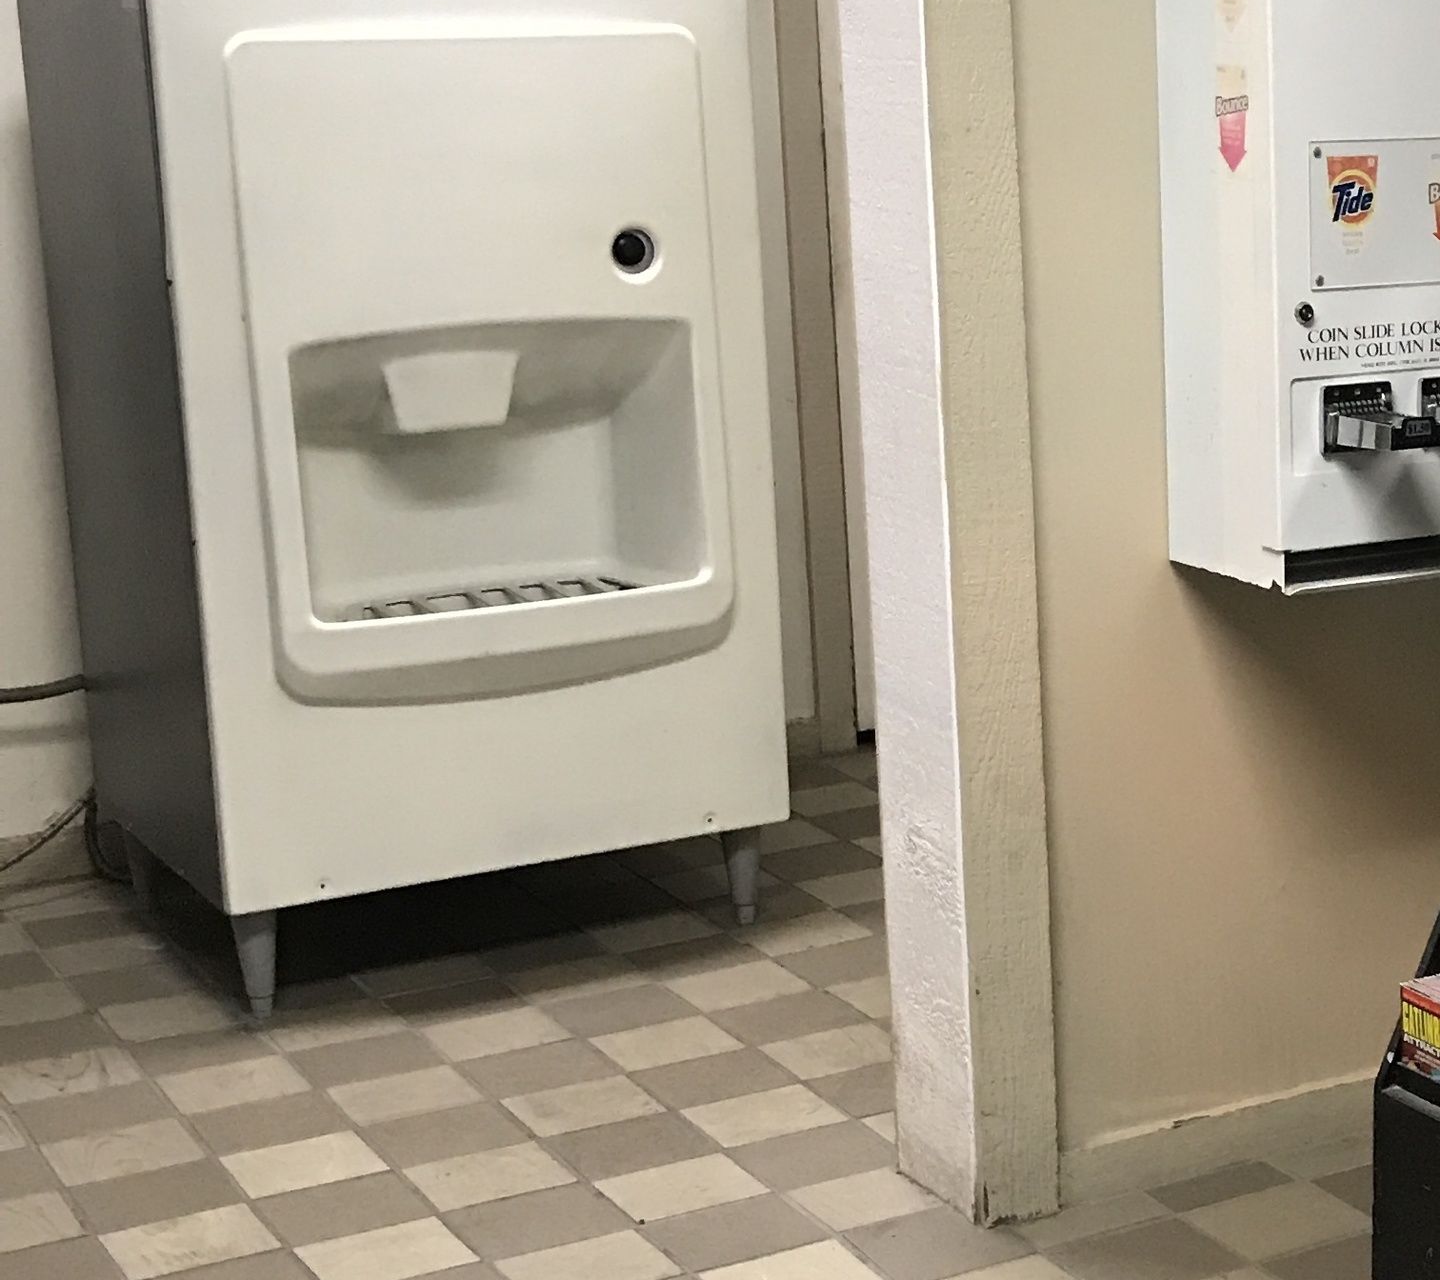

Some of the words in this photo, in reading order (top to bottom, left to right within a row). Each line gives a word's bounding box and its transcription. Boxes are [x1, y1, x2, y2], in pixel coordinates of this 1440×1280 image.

[1215, 95, 1249, 117] Bounce
[1332, 181, 1374, 223] Tide
[1308, 327, 1349, 344] COIN
[1353, 323, 1396, 341] SLIDE
[1299, 344, 1349, 362] WHEN
[1355, 339, 1424, 358] COLUMN
